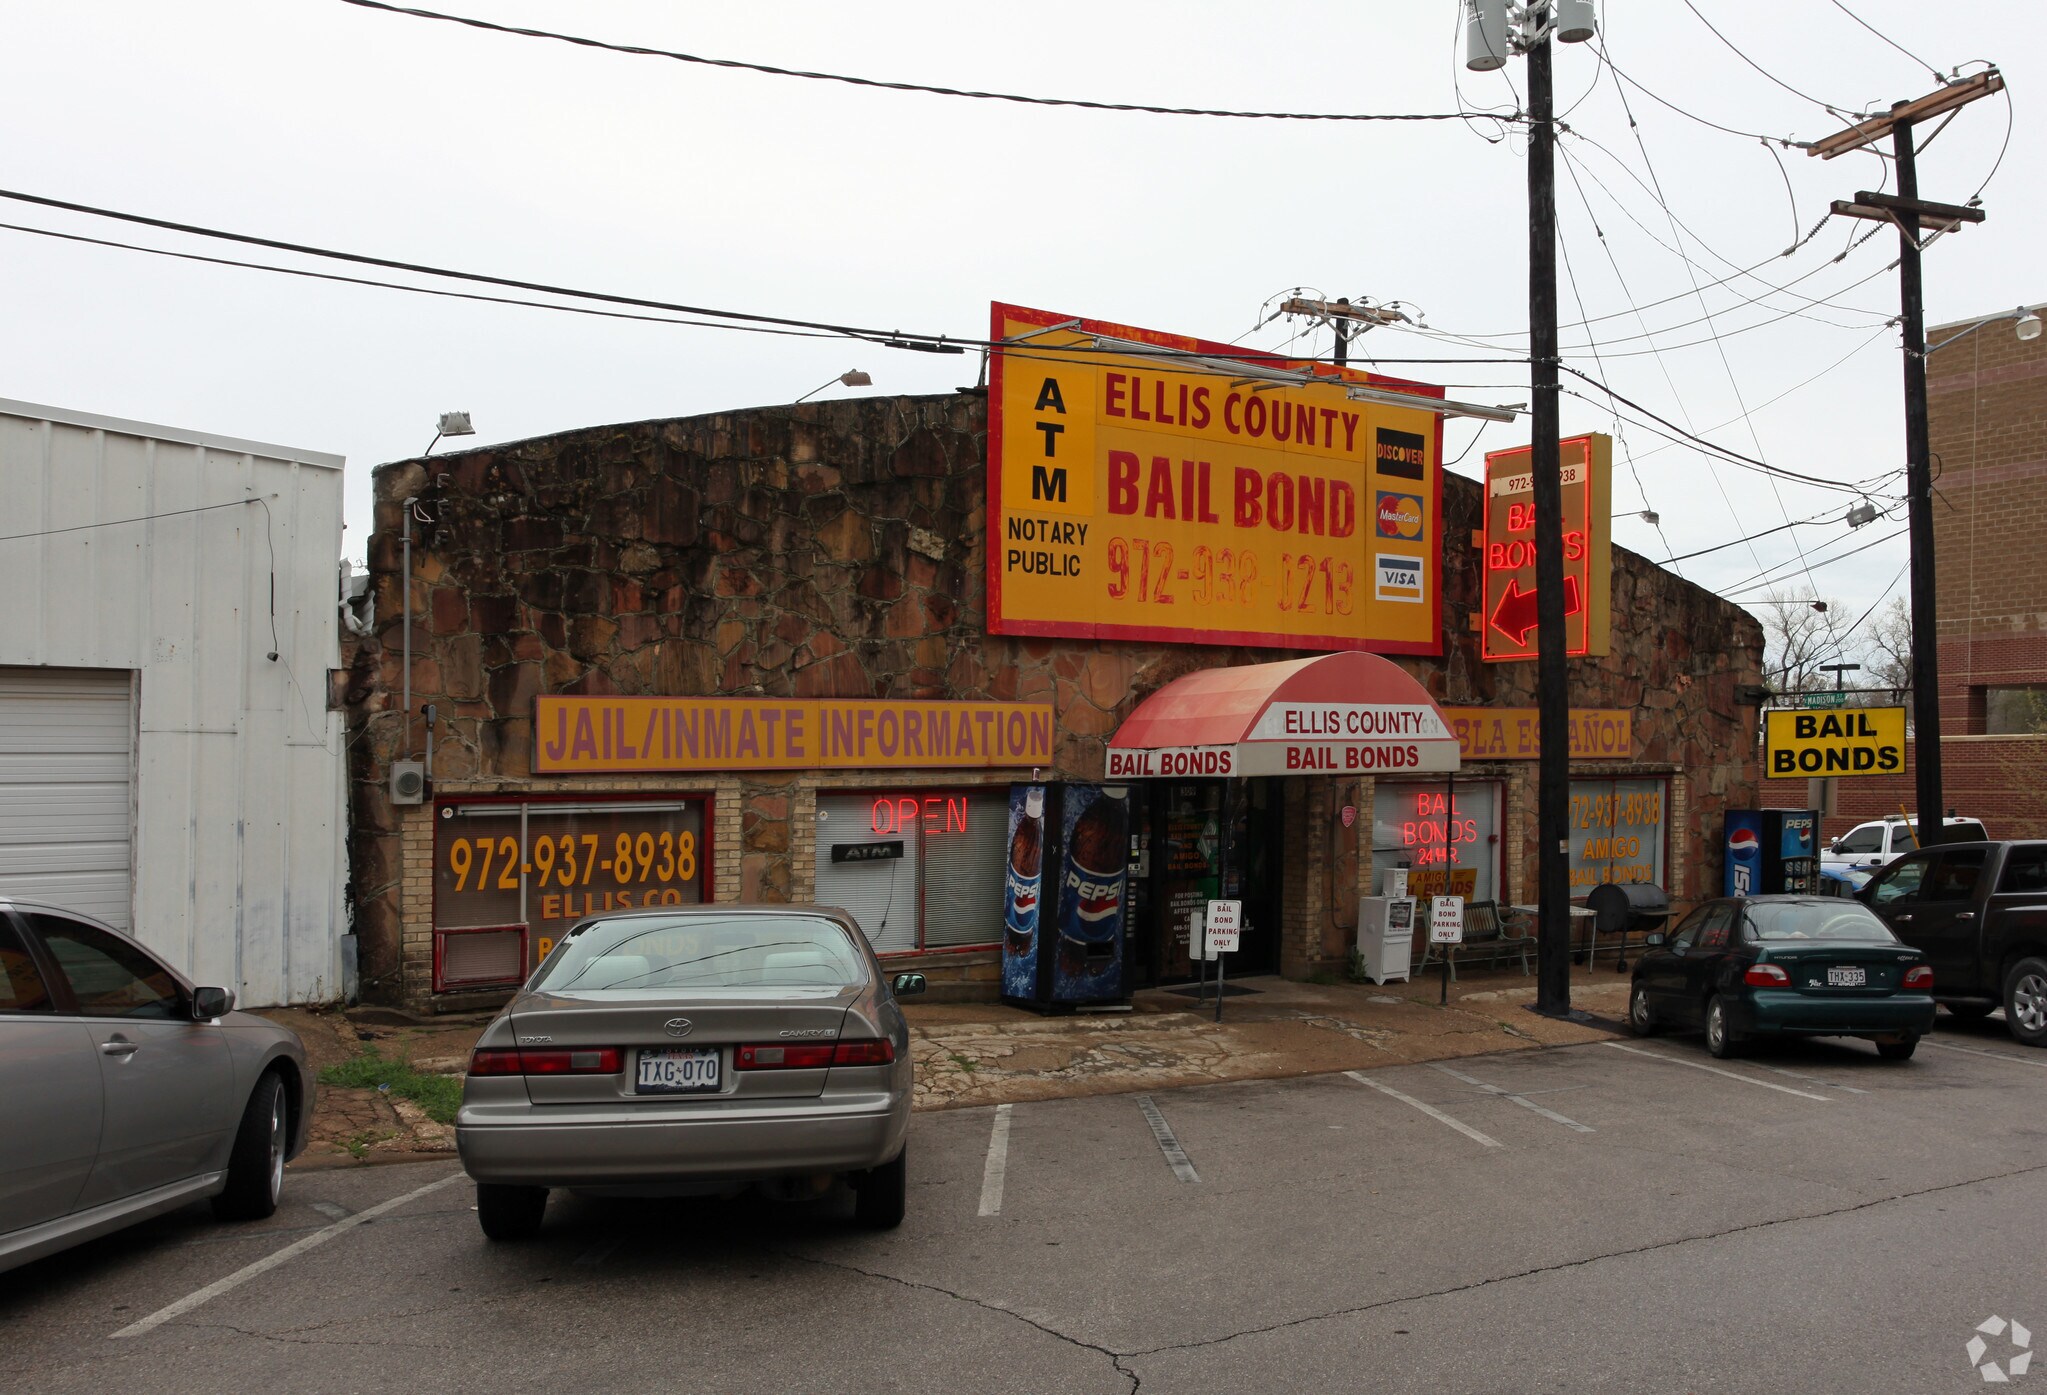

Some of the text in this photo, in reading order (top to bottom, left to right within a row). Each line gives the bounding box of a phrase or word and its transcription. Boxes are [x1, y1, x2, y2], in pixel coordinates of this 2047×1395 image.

[1106, 372, 1359, 452] ELLIS COUNTY
[1377, 443, 1424, 465] DISCOVER
[1108, 449, 1355, 538] BAIL BOND
[1380, 509, 1419, 524] MasterCard
[1008, 517, 1088, 546] NOTARY
[1008, 550, 1081, 578] PUBLIC
[1384, 571, 1417, 586] VISA
[1807, 695, 1835, 705] MADISON
[546, 707, 1049, 761] JAIL/INMATE INFORMATION
[1285, 711, 1340, 734] ELLIS
[1347, 711, 1423, 734] COUNTY
[1796, 714, 1877, 739] BAIL
[1110, 750, 1232, 776] BAIL BONDS
[1286, 745, 1419, 769] BAIL BONDS
[1774, 746, 1899, 773] BONDS
[872, 797, 967, 834] OPEN
[1404, 820, 1477, 845] BONDS
[845, 844, 892, 860] ATM
[1583, 836, 1639, 860] AMIGO
[451, 831, 696, 892] 972-937-8938
[1602, 863, 1652, 885] BONDS
[1008, 876, 1041, 899] PEPSI
[1066, 870, 1123, 901] PEPSI
[542, 890, 632, 920] ELLIS
[779, 1030, 823, 1038] CAMRY
